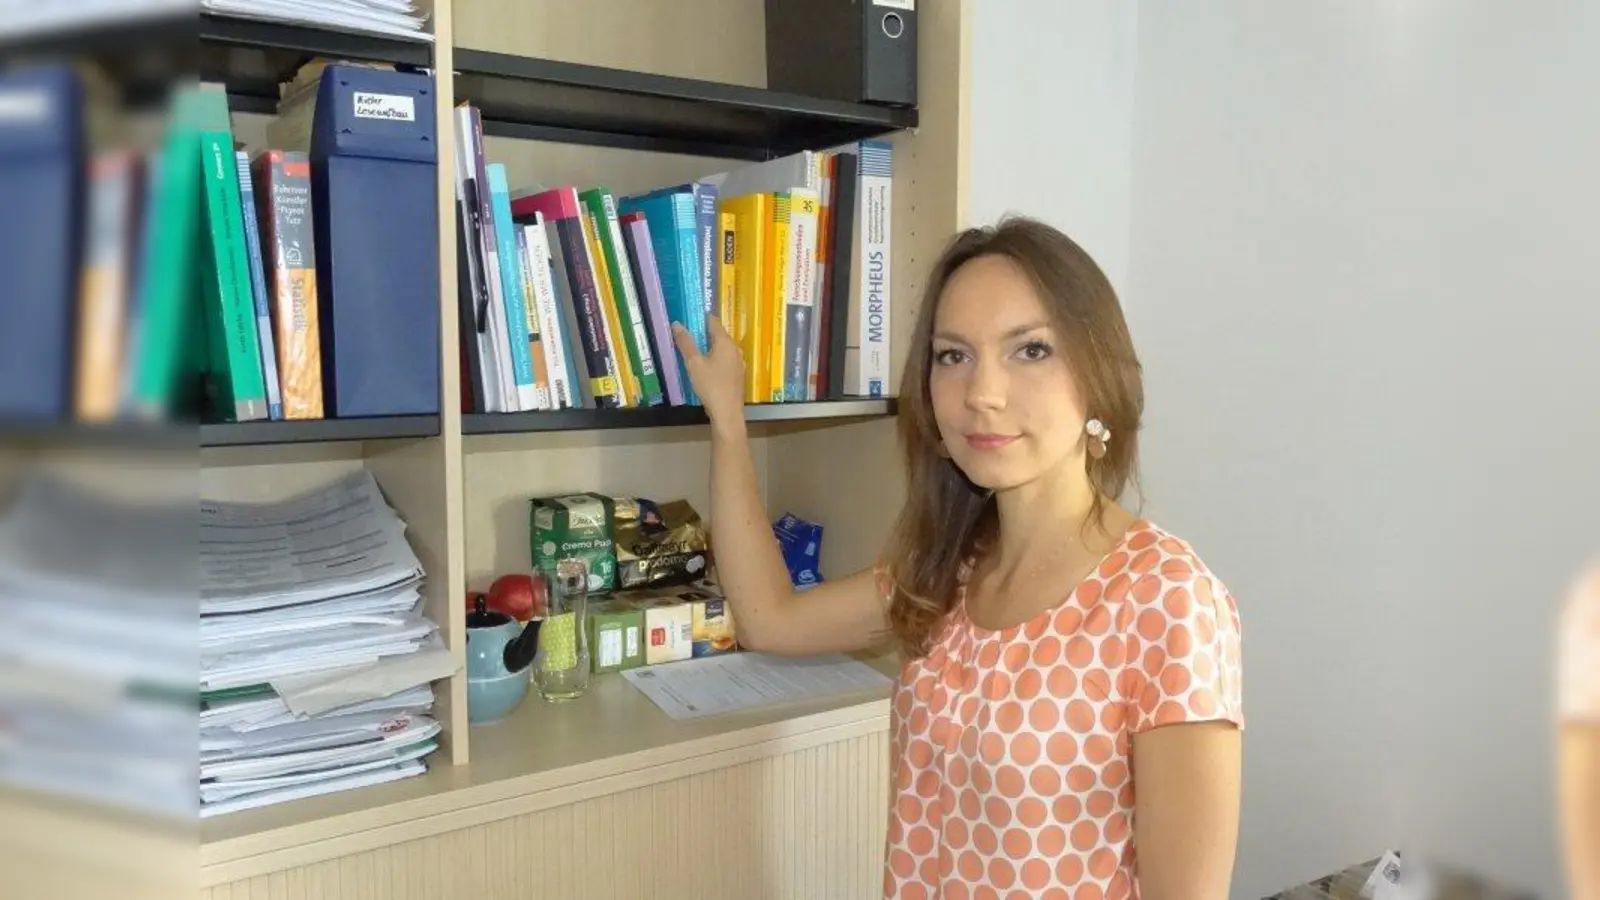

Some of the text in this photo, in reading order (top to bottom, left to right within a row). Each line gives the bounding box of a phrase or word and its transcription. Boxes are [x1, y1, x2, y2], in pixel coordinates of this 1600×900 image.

[704, 225, 712, 277] Introduction
[726, 235, 734, 264] DUDEN
[868, 251, 884, 343] MORPHEUS
[561, 541, 592, 551] Crema
